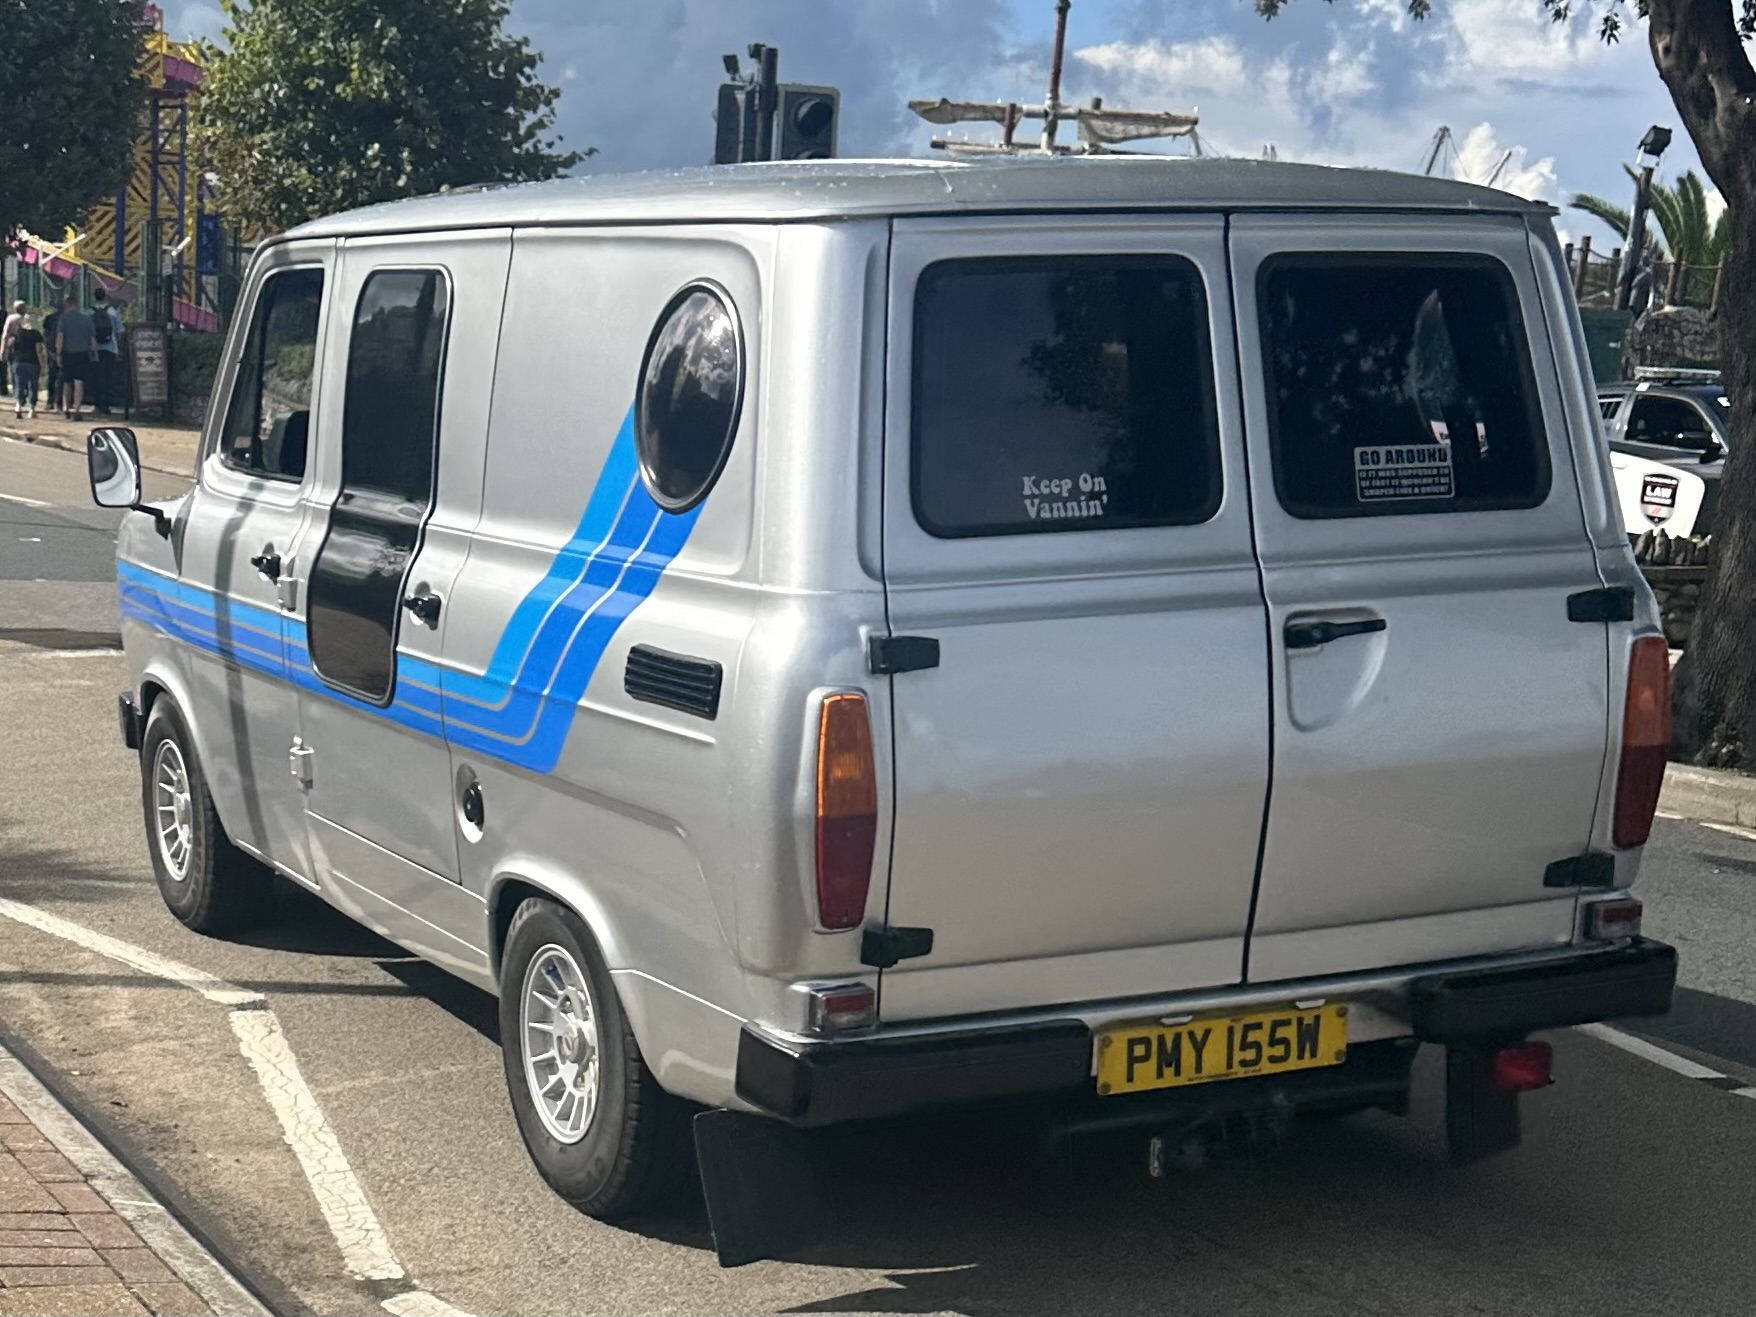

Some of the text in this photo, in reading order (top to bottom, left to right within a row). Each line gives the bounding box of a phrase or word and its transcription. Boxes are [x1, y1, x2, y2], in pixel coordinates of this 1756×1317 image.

[1360, 448, 1448, 466] GO AROUND
[1022, 472, 1106, 497] Keep On
[1645, 485, 1673, 499] LAW
[1024, 494, 1108, 519] Vannin'
[1126, 1014, 1321, 1083] PMY 155W
